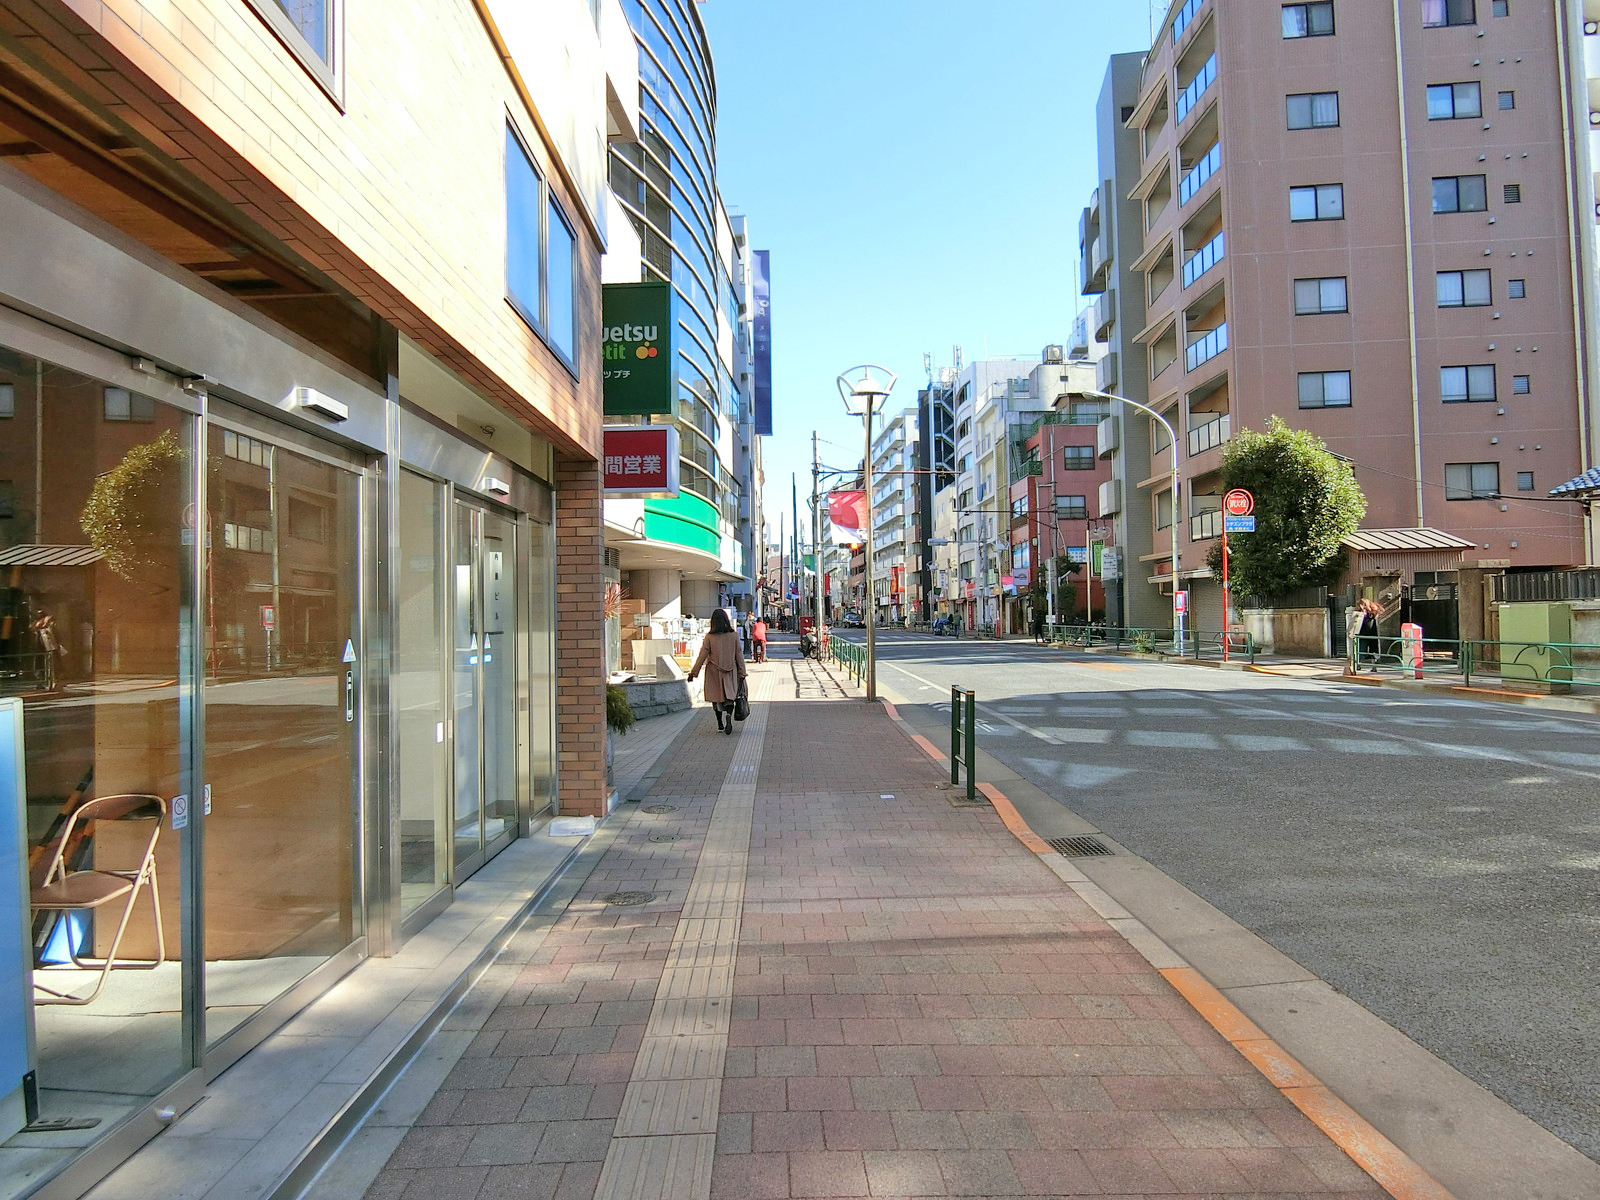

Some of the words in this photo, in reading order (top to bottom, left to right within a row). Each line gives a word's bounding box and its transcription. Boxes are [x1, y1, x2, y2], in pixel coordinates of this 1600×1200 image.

[603, 343, 626, 360] tit
[605, 454, 661, 475] 間営業
[1229, 499, 1247, 508] 消火栓
